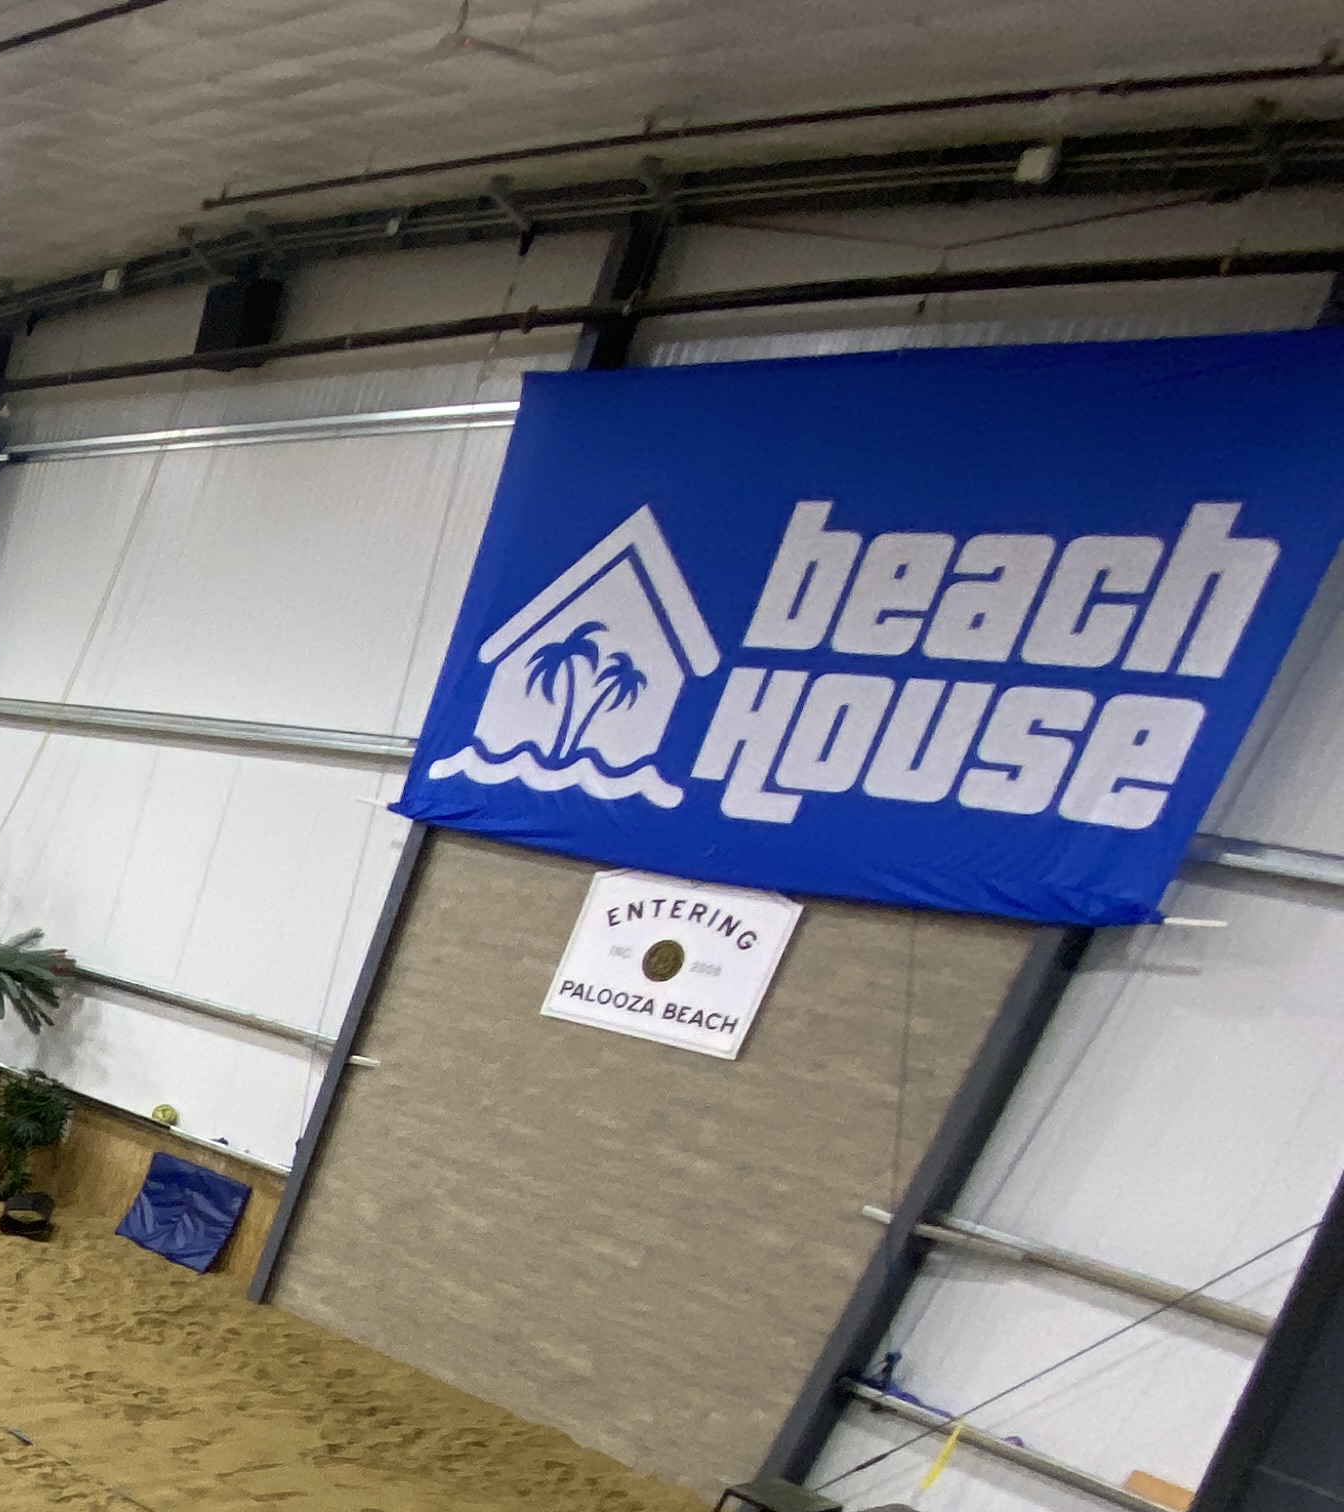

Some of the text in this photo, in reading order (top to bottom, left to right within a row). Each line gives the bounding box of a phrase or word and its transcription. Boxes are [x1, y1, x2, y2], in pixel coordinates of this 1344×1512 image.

[742, 500, 1281, 679] beach
[606, 899, 759, 951] ENTERING
[559, 979, 740, 1034] PALOOZA BEACH
